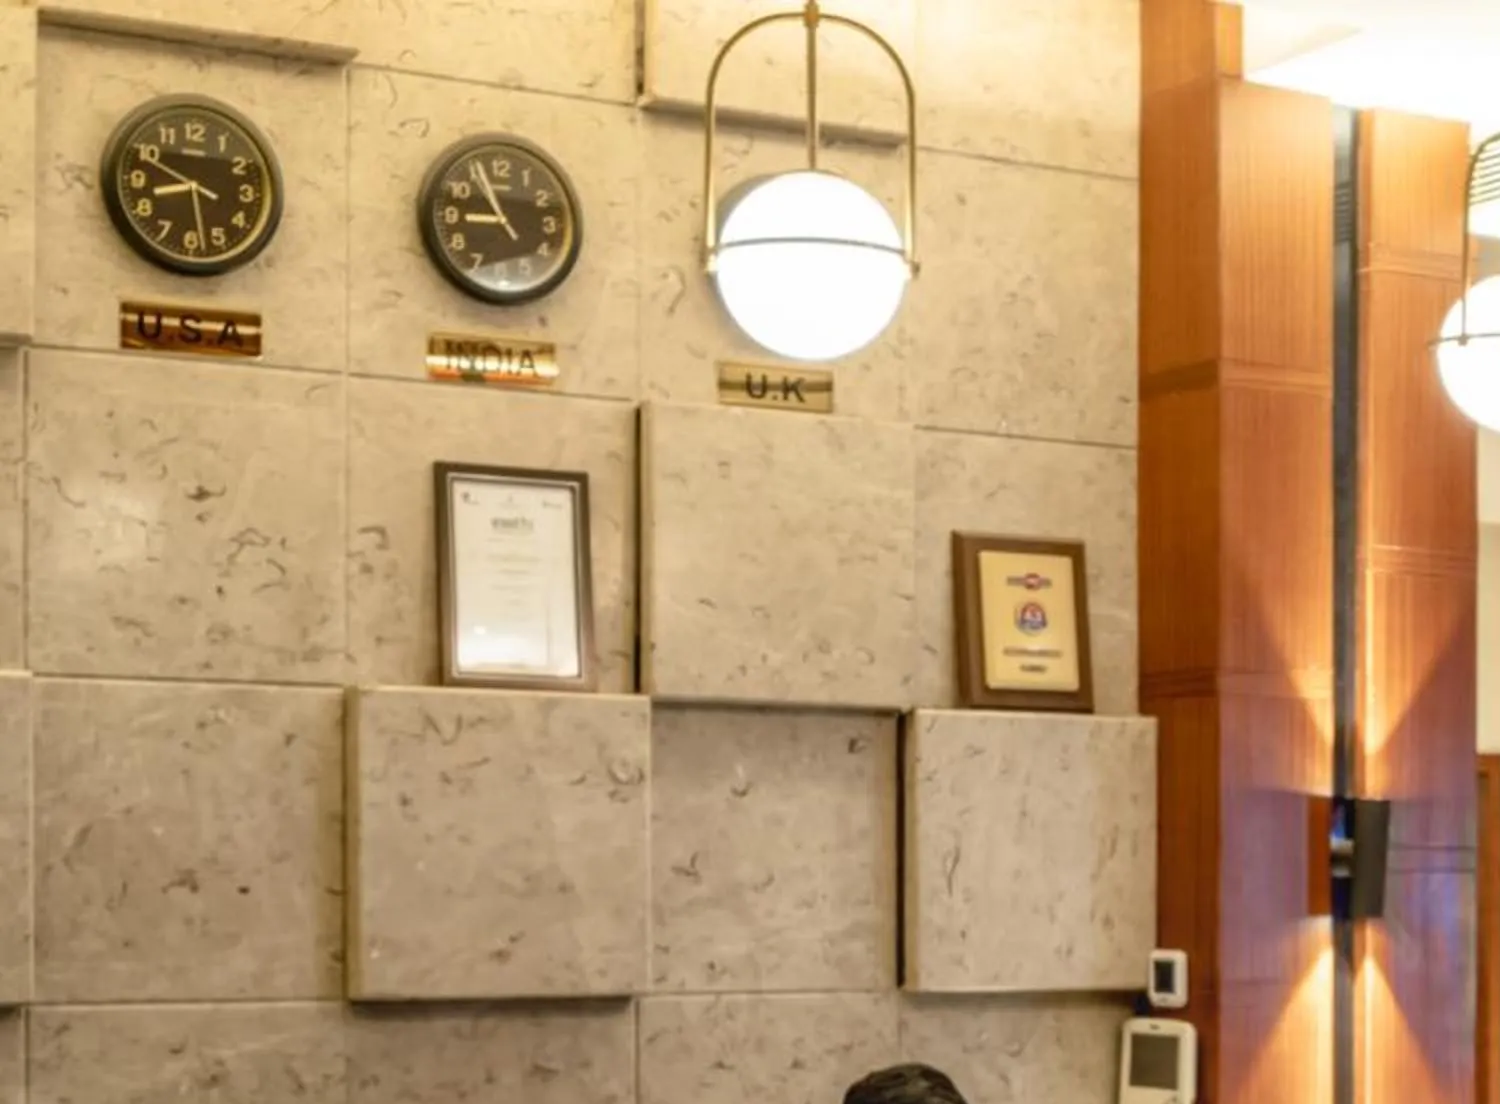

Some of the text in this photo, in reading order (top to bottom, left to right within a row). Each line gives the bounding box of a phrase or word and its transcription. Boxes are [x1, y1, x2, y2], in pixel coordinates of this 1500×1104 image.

[159, 126, 175, 145] 11
[184, 123, 206, 142] 12
[139, 143, 160, 162] 10
[217, 134, 228, 152] 1
[231, 156, 247, 175] 2
[492, 160, 511, 177] 12
[130, 169, 146, 188] 9
[522, 168, 531, 187] 1
[239, 184, 254, 202] 3
[450, 181, 470, 199] 10
[535, 190, 549, 207] 2
[137, 198, 153, 217] 8
[444, 206, 459, 224] 9
[231, 211, 245, 228] 4
[542, 216, 556, 234] 3
[156, 219, 172, 241] 7
[183, 230, 198, 249] 6
[211, 227, 226, 245] 5
[451, 232, 465, 250] 8
[537, 243, 549, 256] 4
[469, 253, 483, 274] 7
[445, 338, 539, 378] INDIA
[745, 372, 806, 403] U.K
